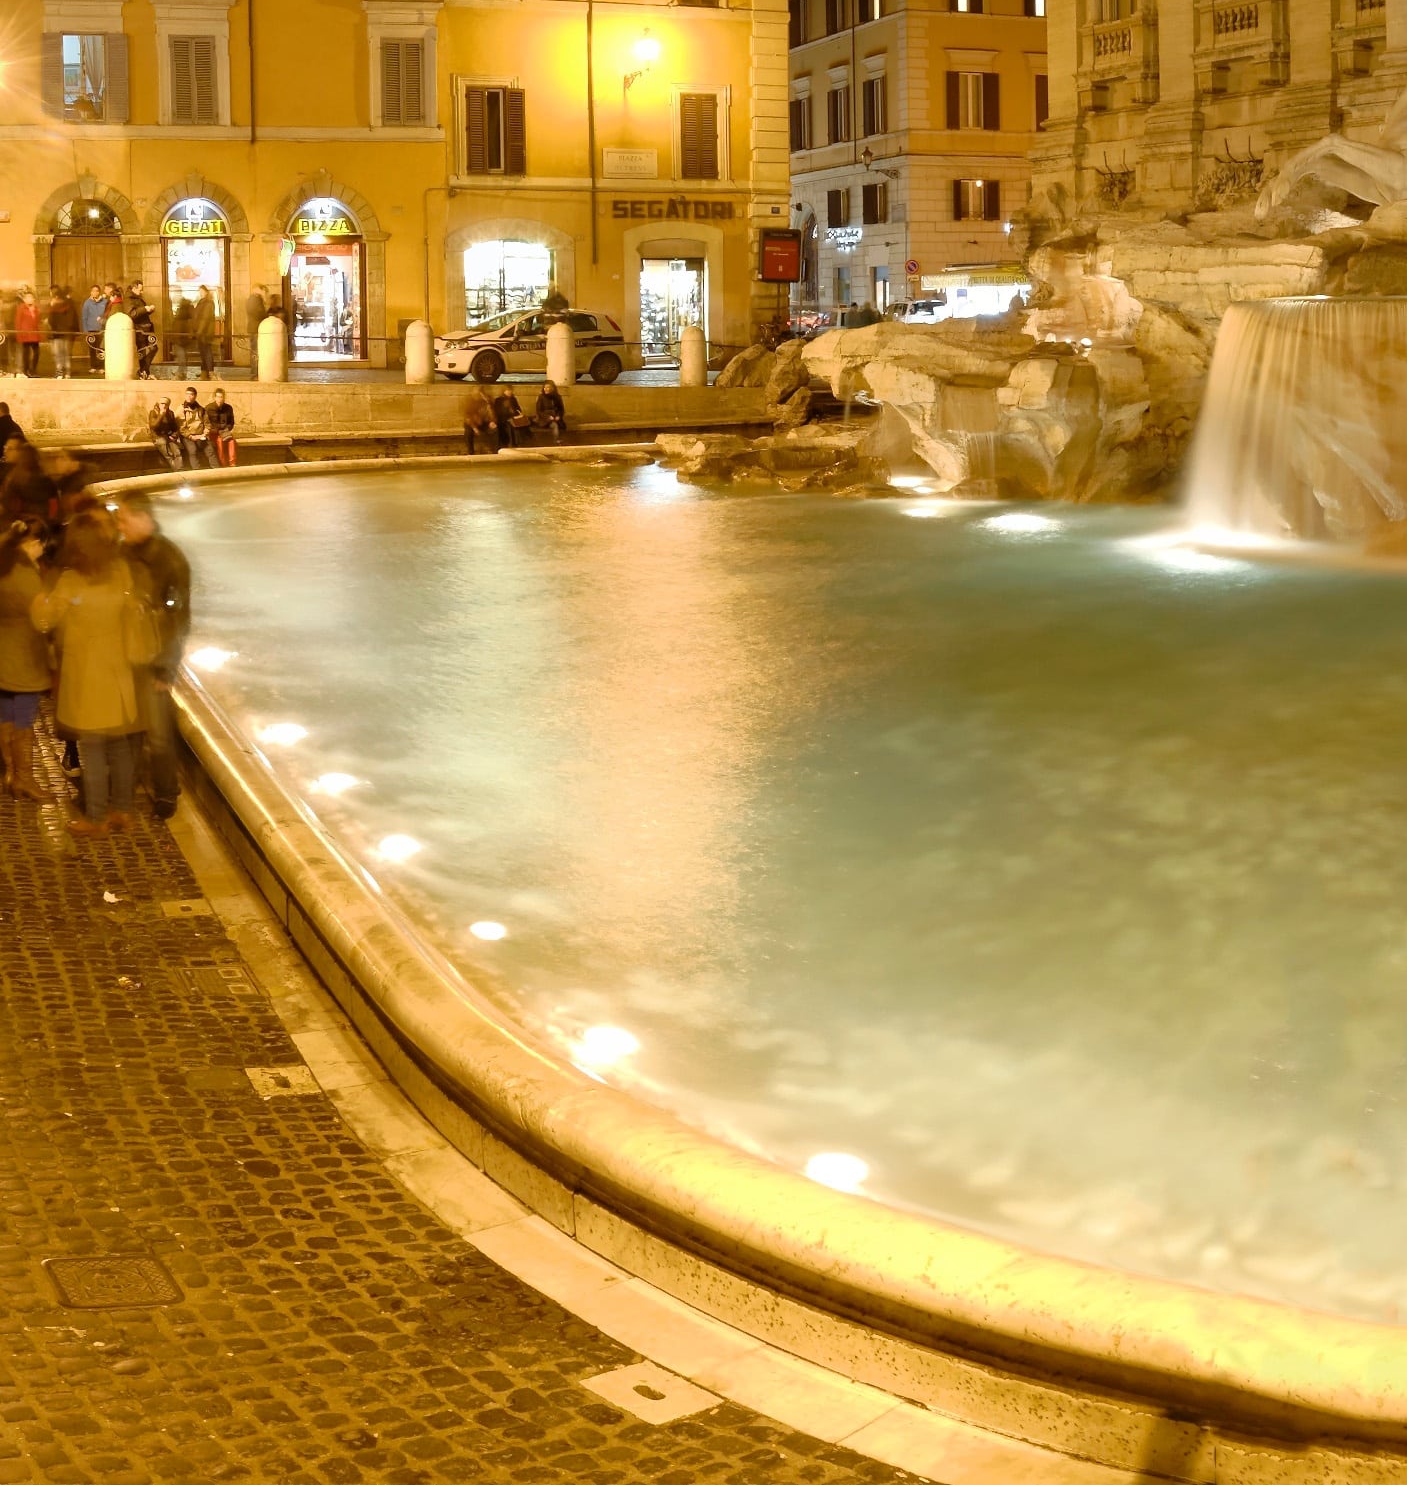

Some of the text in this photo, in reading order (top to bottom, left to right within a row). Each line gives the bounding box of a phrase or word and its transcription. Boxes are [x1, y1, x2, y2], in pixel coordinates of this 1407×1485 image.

[612, 200, 734, 219] SEGATORI
[166, 220, 224, 234] GELATI
[300, 219, 350, 232] PIZZA
